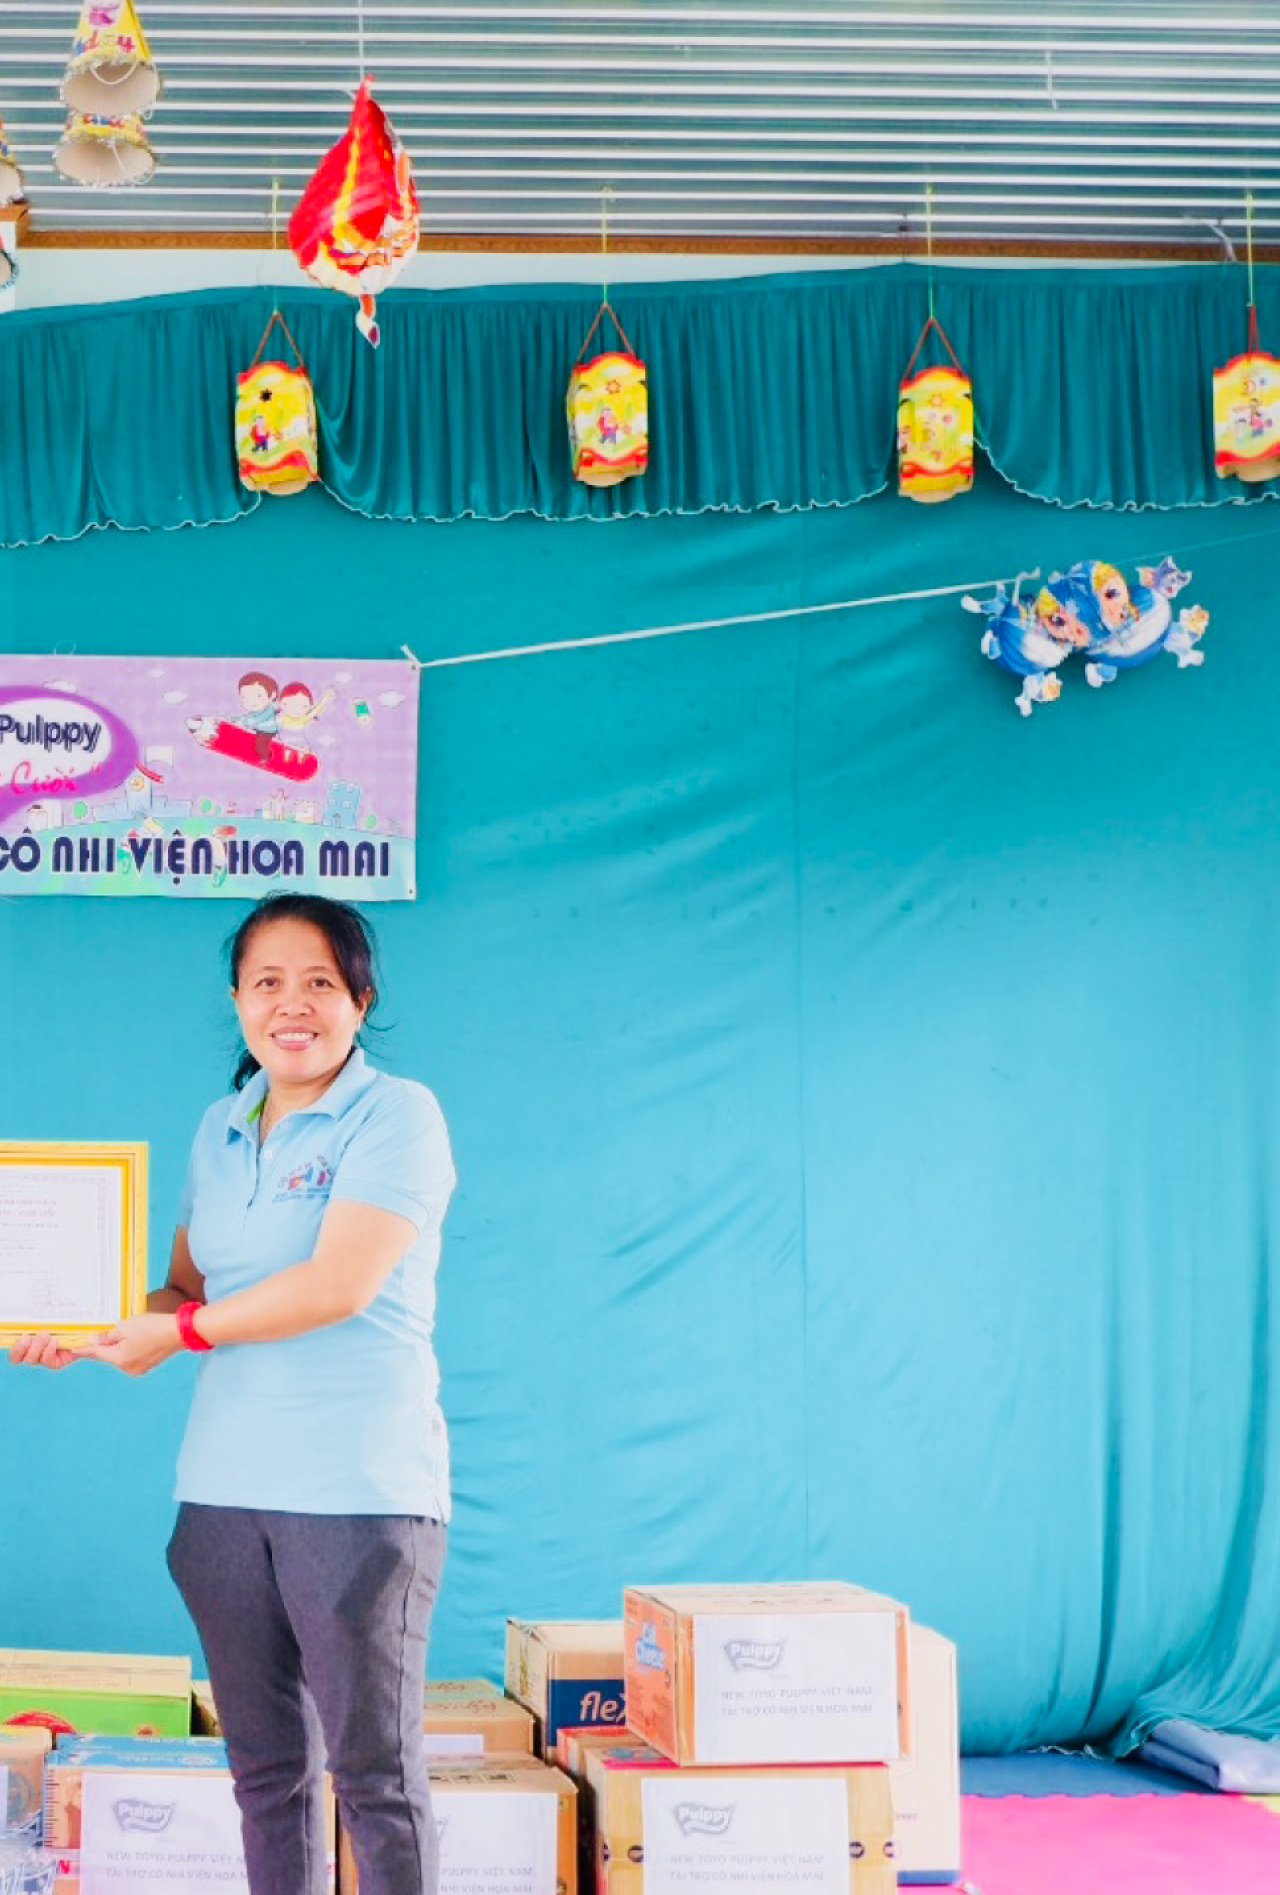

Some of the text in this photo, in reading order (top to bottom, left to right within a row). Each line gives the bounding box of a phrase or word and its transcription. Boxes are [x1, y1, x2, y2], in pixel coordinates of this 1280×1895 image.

[10, 760, 79, 794] Cười
[51, 836, 116, 873] NHI
[127, 828, 214, 885] VIỆN
[228, 839, 305, 877] HOA
[318, 839, 391, 877] MAI
[731, 1644, 782, 1660] Pulppy
[119, 1802, 171, 1819] Pulppy
[679, 1807, 731, 1823] Pulppy
